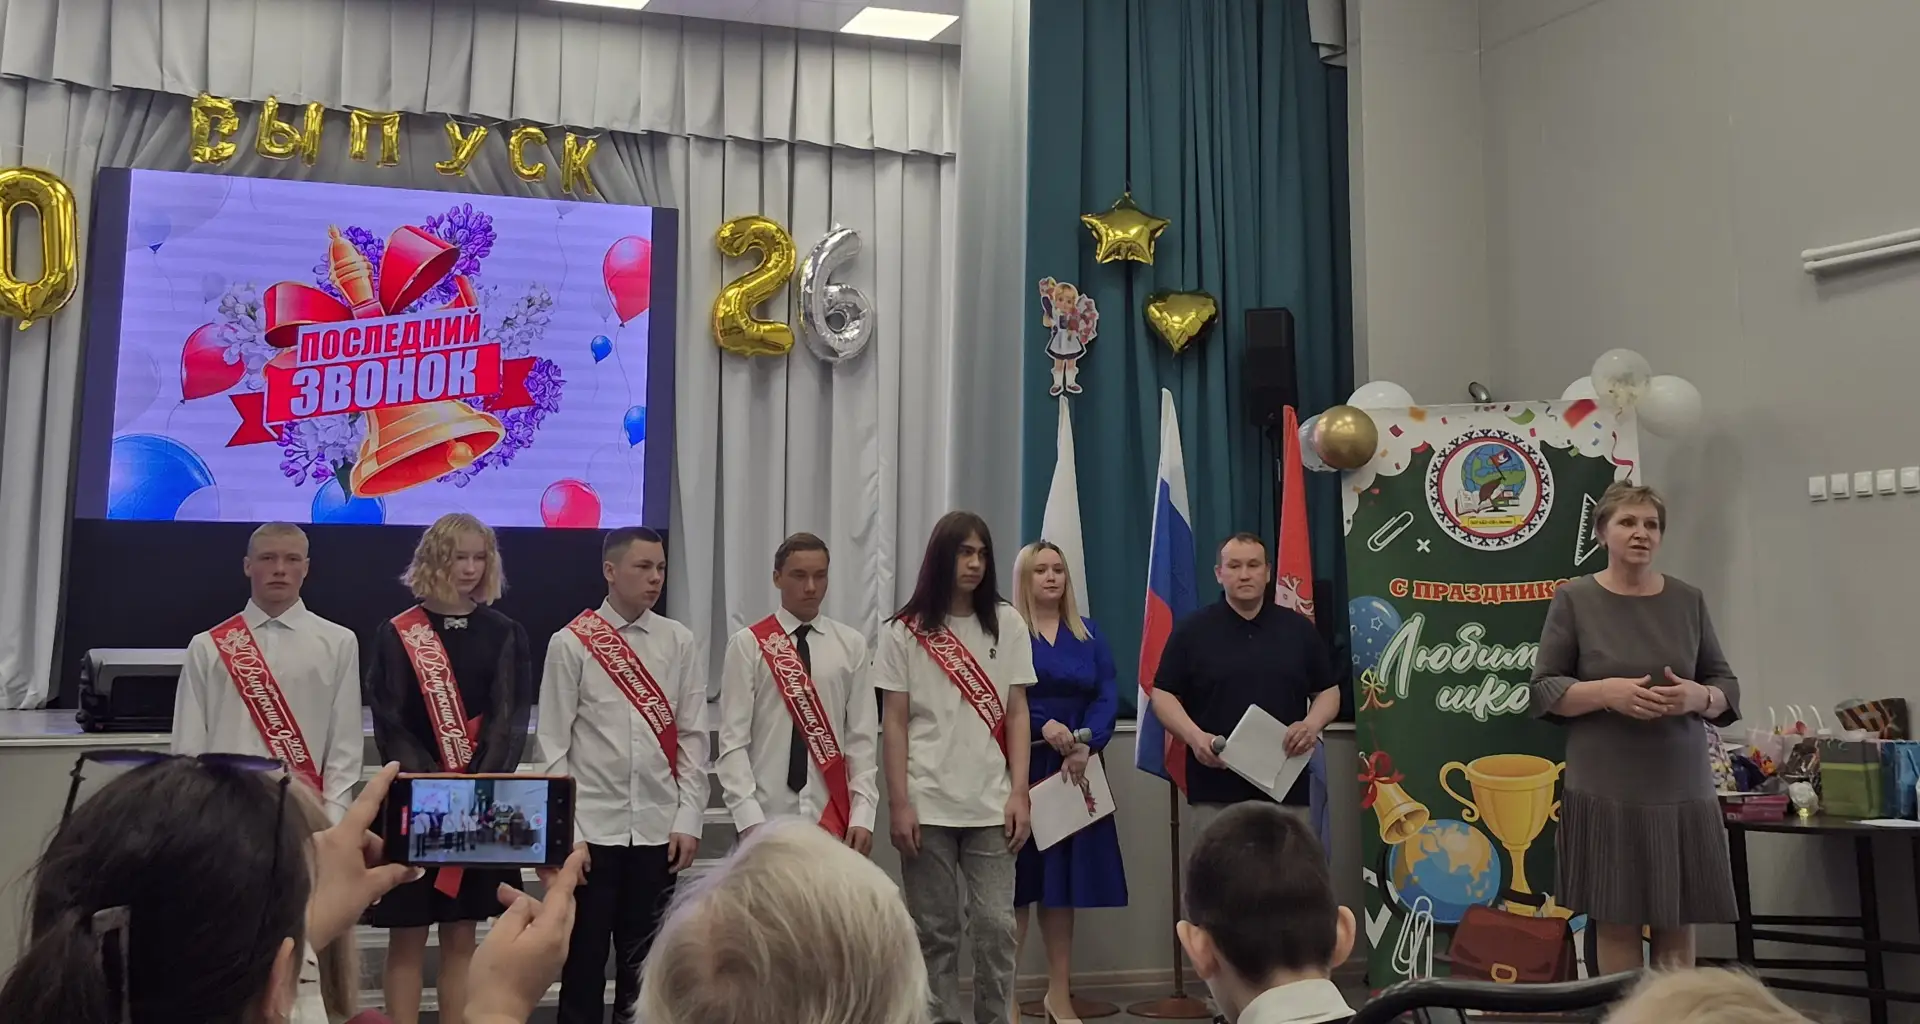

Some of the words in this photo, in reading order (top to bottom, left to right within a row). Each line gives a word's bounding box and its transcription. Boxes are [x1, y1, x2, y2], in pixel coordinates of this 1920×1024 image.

[190, 94, 598, 194] ВЫПУСК
[300, 308, 482, 362] ПОСЛЕДНИЙ
[290, 348, 479, 417] ЗВОНОК
[1389, 578, 1409, 598] С
[1413, 578, 1575, 605] ПРАЗДНИК
[415, 646, 456, 728] Выпускник
[589, 631, 650, 699] Выпускник
[926, 632, 985, 696] Выпускник
[1378, 612, 1540, 699] Любим
[231, 652, 284, 731] Выпускник
[773, 654, 818, 728] Выпускник
[1436, 673, 1532, 723] шко
[289, 738, 309, 763] 2026
[821, 734, 839, 758] 2026
